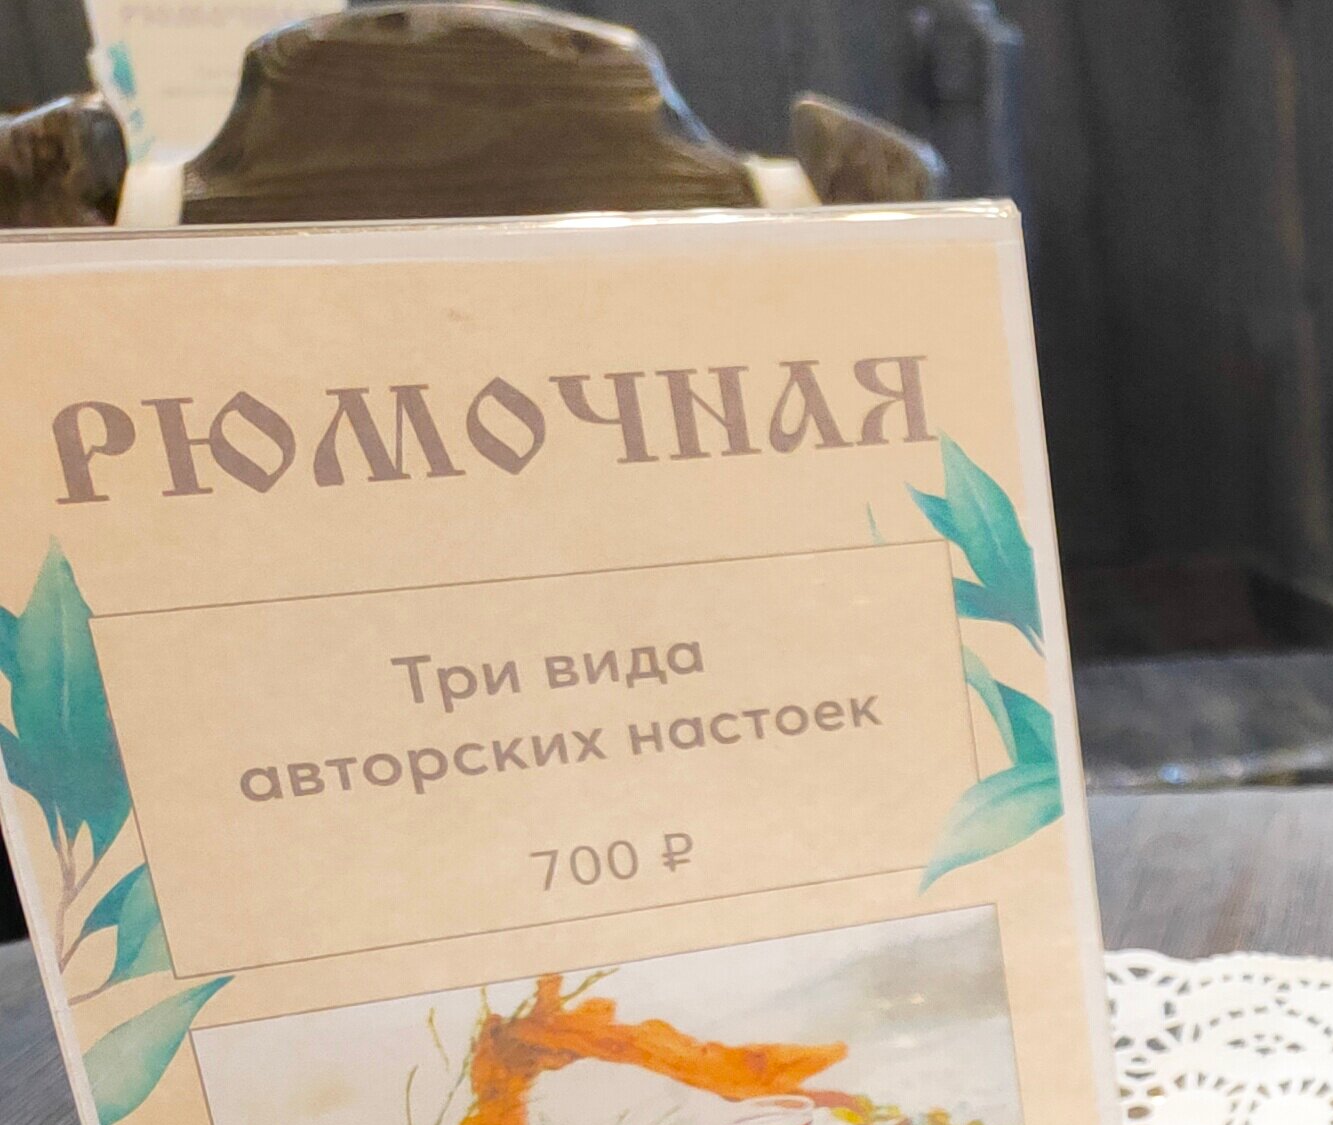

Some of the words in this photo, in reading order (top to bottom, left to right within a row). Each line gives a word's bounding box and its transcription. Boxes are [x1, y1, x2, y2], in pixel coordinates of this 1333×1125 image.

[52, 355, 938, 505] РЮМОЧНАЯ
[390, 653, 521, 714] Три
[544, 640, 705, 690] вида
[239, 727, 608, 803] авторских
[628, 693, 883, 757] настоек
[529, 839, 640, 892] 700
